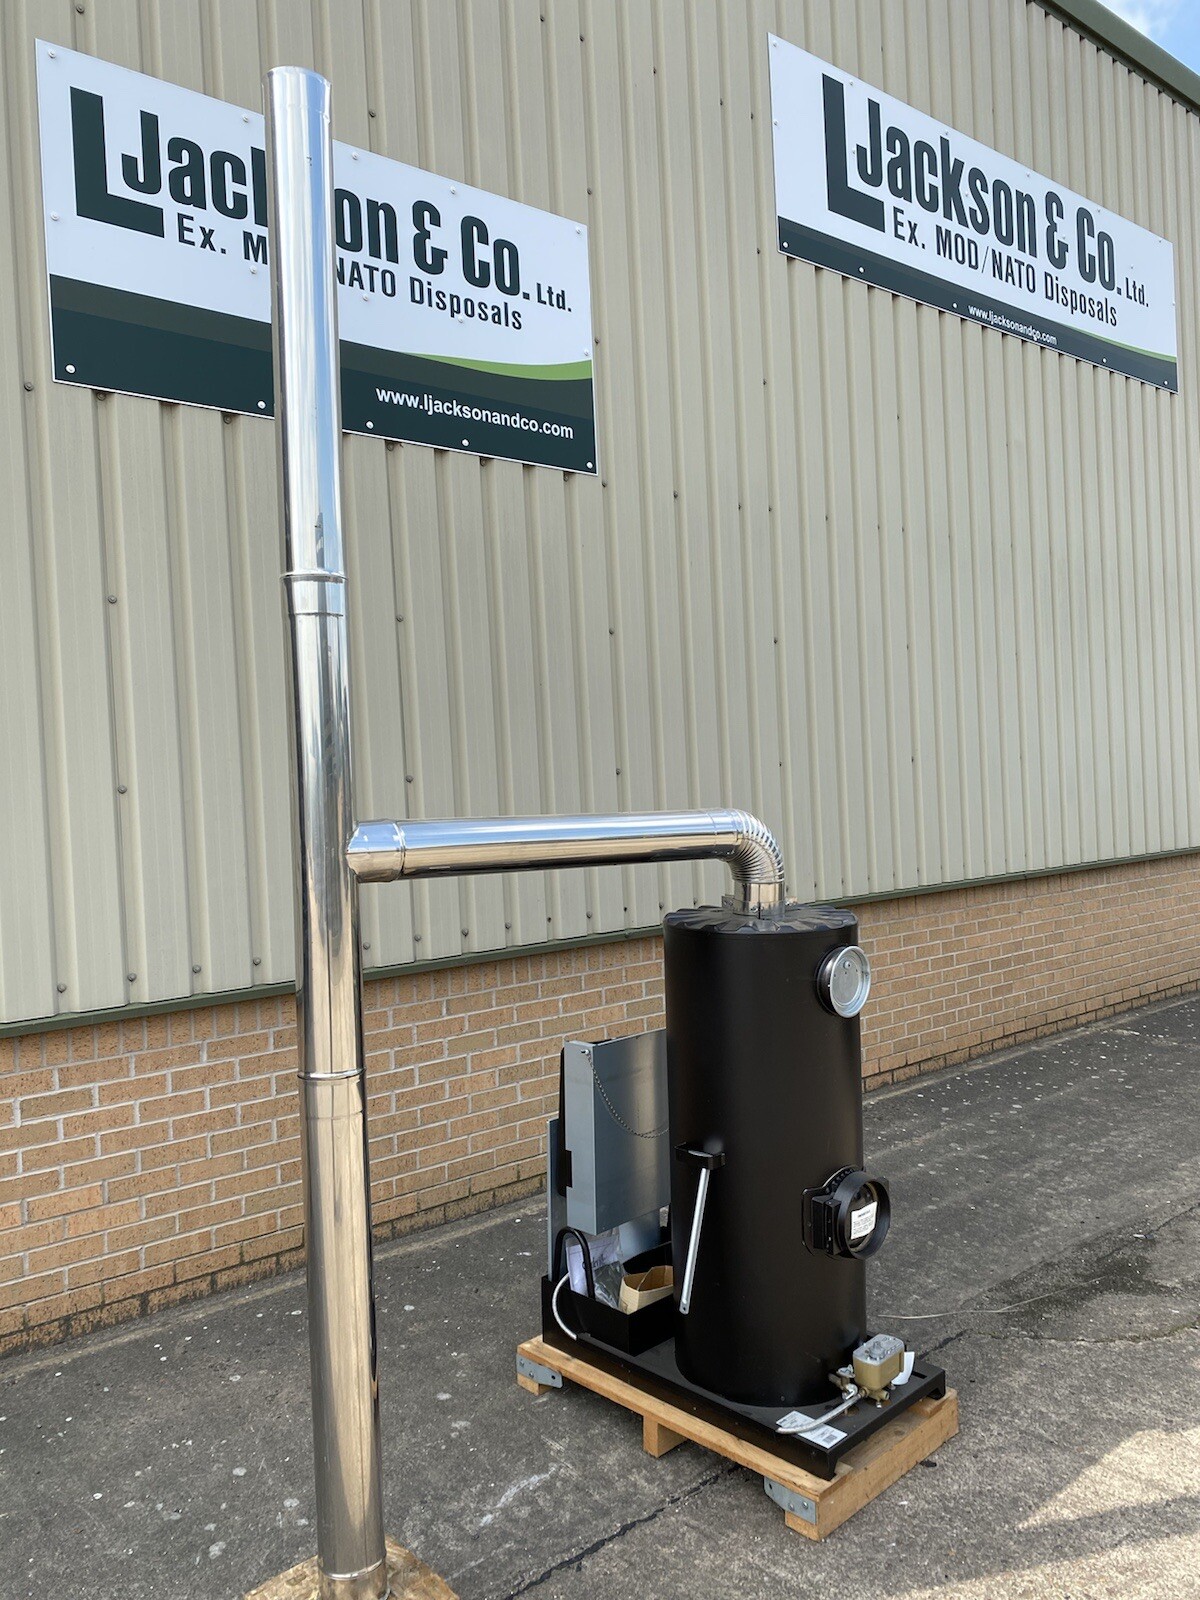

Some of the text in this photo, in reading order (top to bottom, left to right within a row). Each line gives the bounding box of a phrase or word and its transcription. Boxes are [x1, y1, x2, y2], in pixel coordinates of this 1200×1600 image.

[177, 212, 227, 255] Ex.
[409, 275, 523, 331] Disposals
[412, 199, 448, 275] &
[460, 215, 530, 301] Co.
[536, 282, 573, 312] Ltd.
[893, 205, 1118, 328] Ex. MOD/NATO Disposals
[1045, 190, 1069, 270] &
[1076, 206, 1122, 296] Co.
[1125, 276, 1149, 308] Ltd.
[968, 304, 1058, 346] www.ljacksonandco.com
[375, 386, 575, 440] www.ljacksonandco.com
